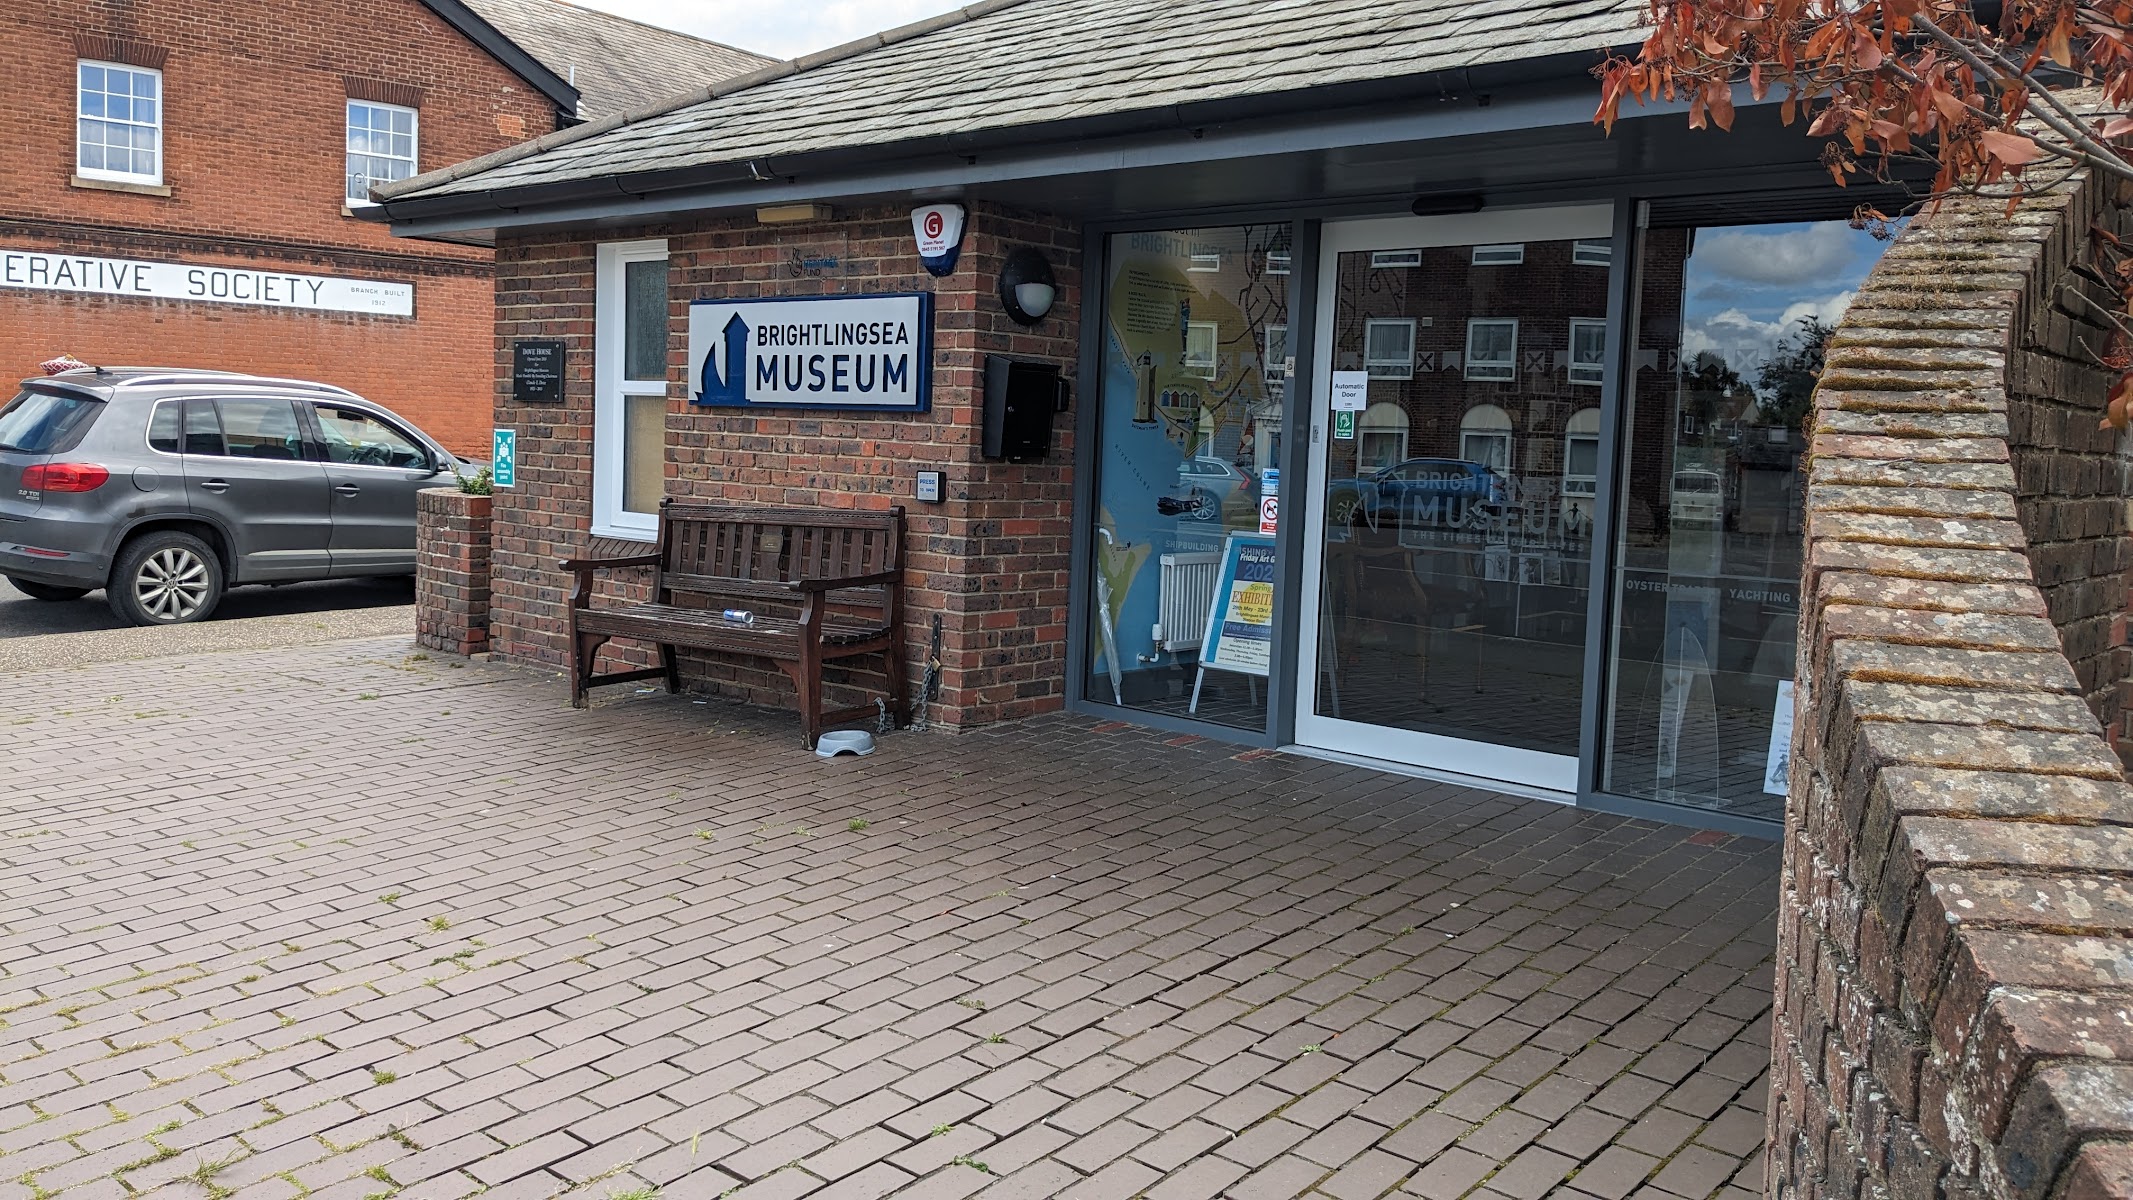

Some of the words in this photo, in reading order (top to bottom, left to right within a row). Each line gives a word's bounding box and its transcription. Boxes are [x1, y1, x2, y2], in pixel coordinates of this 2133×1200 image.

[925, 215, 938, 235] G
[6, 254, 152, 292] ERATIVE
[188, 269, 324, 304] SOCIETY
[350, 287, 378, 295] BRANCH
[757, 322, 909, 347] BRIGHTLINGSEA
[756, 353, 908, 392] MUSEUM
[1412, 495, 1587, 538] MUSEUM
[1413, 530, 1436, 540] THE
[1442, 533, 1481, 544] TIMES
[1165, 539, 1219, 553] SHIPBUILDING
[1240, 553, 1257, 564] Friday
[1259, 555, 1269, 563] Art
[1250, 583, 1271, 592] Spring
[1626, 579, 1668, 593] OYSTER
[1729, 588, 1791, 603] YACHTING
[1225, 623, 1241, 631] Free
[1233, 637, 1250, 646] Opening
